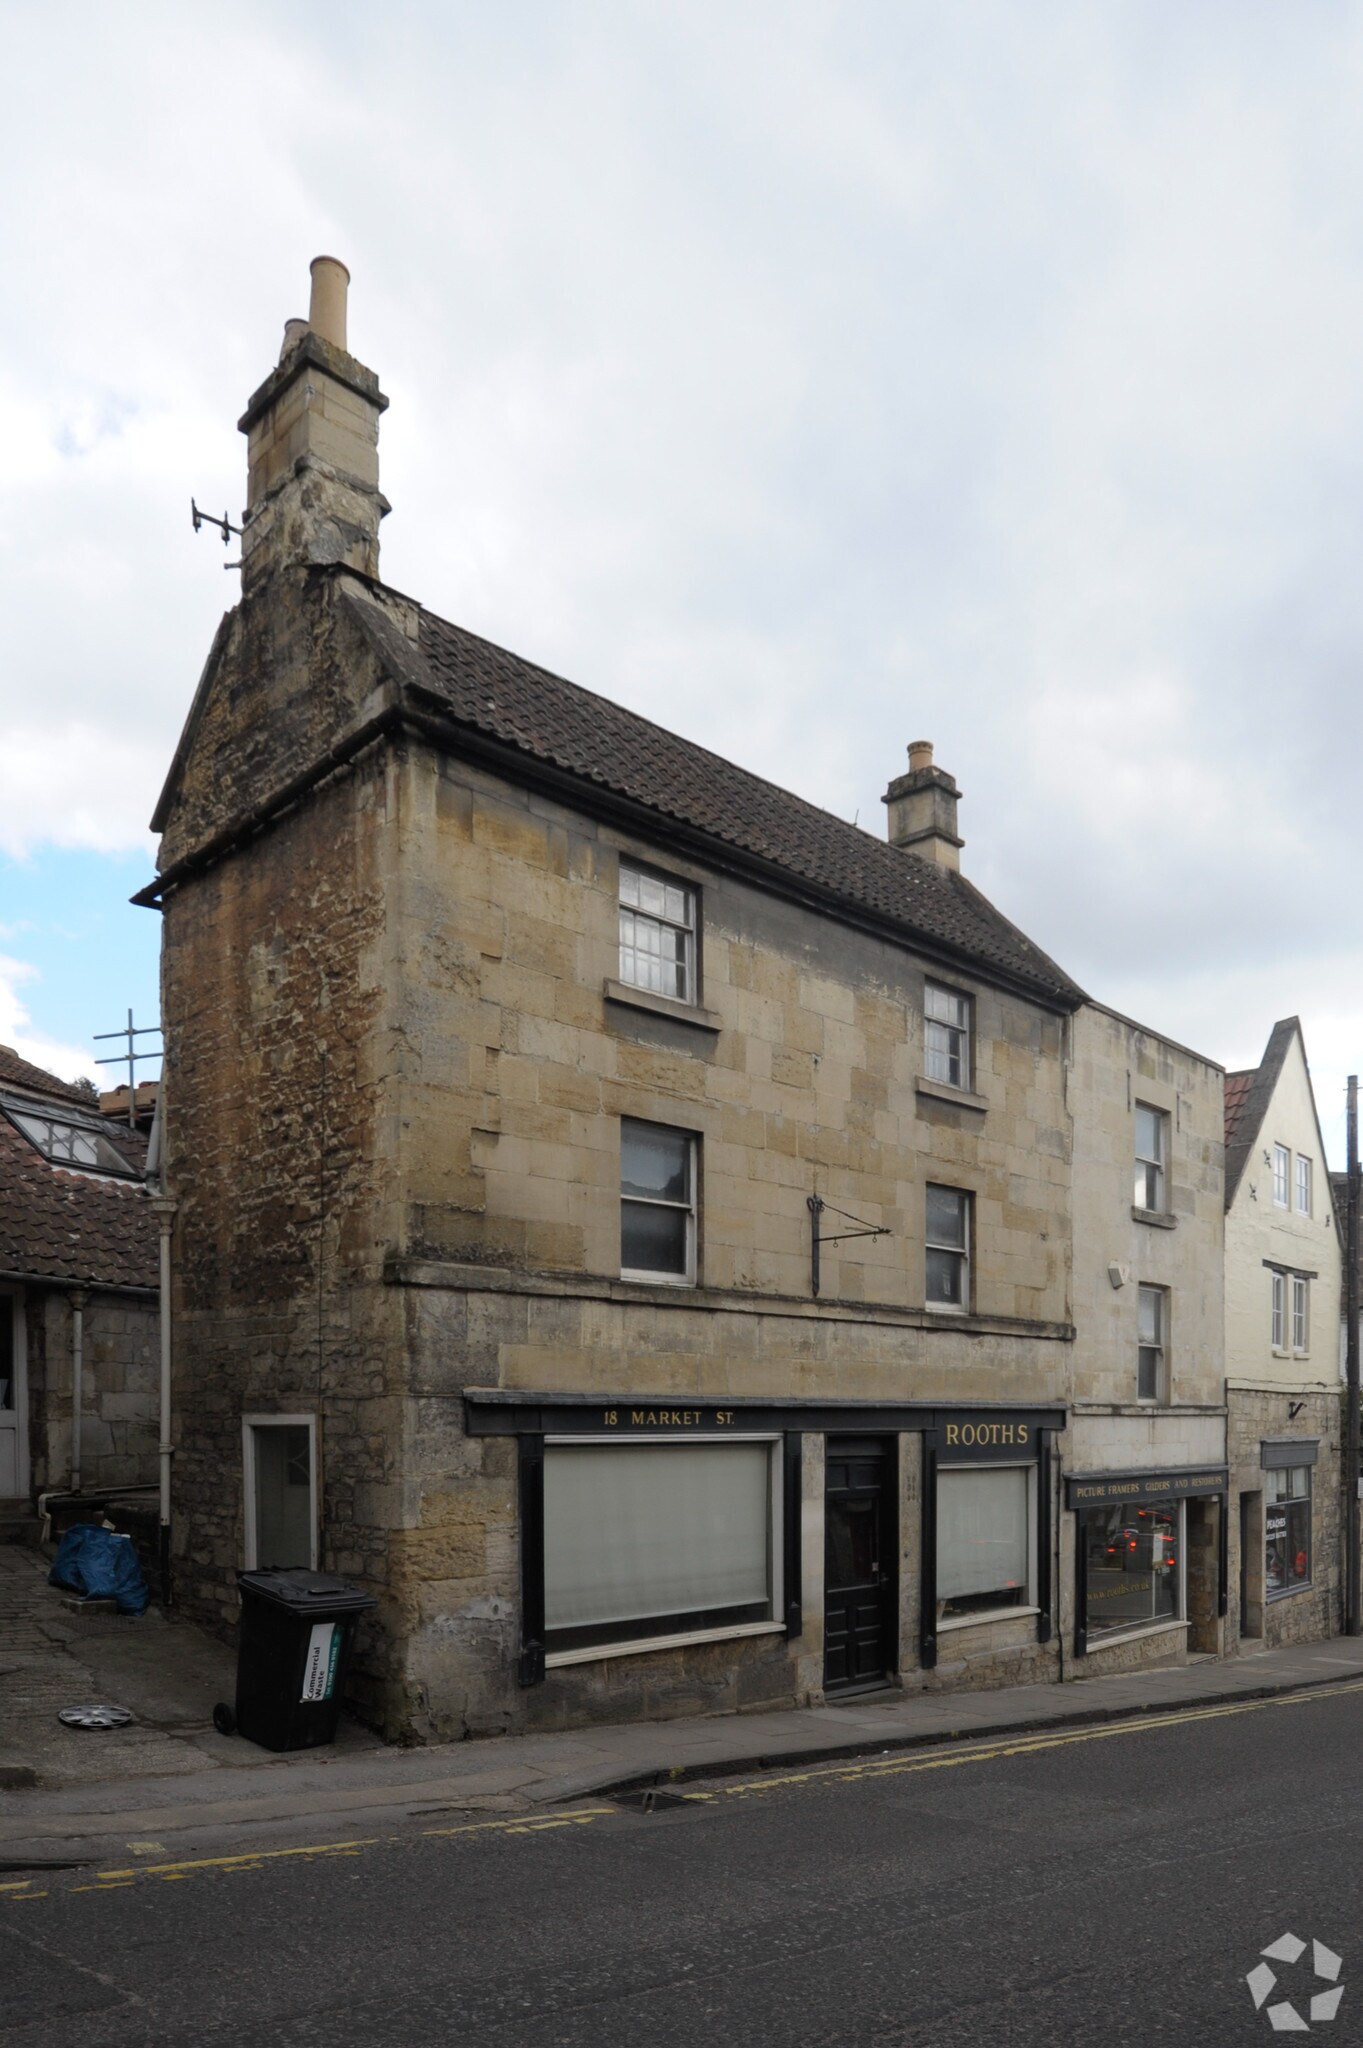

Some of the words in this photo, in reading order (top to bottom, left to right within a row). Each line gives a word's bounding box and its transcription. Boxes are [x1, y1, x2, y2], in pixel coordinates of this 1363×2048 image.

[603, 1410, 618, 1425] 18
[631, 1411, 702, 1425] MARKET
[716, 1411, 735, 1425] ST.
[946, 1424, 1028, 1446] ROOTHS
[1076, 1486, 1106, 1498] PICTURE
[1108, 1483, 1140, 1495] FRAMERS
[1145, 1480, 1171, 1492] GILDERS
[1174, 1478, 1188, 1489] AND
[307, 1647, 320, 1699] Commercial
[315, 1670, 325, 1698] Waste
